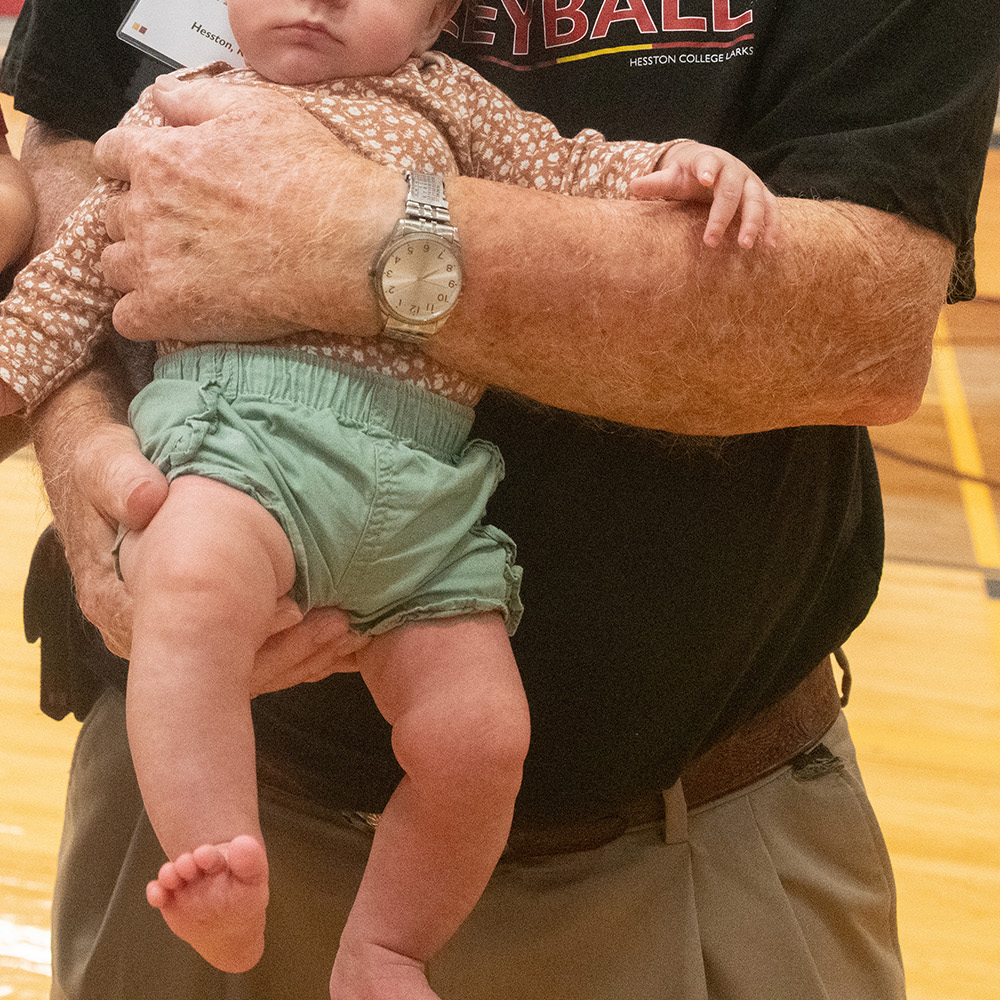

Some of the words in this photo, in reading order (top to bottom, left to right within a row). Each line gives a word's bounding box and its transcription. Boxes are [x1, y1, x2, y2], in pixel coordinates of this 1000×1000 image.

[191, 22, 234, 53] Hesston,
[630, 55, 676, 67] HESSTON
[679, 53, 724, 63] COLLEGE
[725, 46, 754, 60] LARKS
